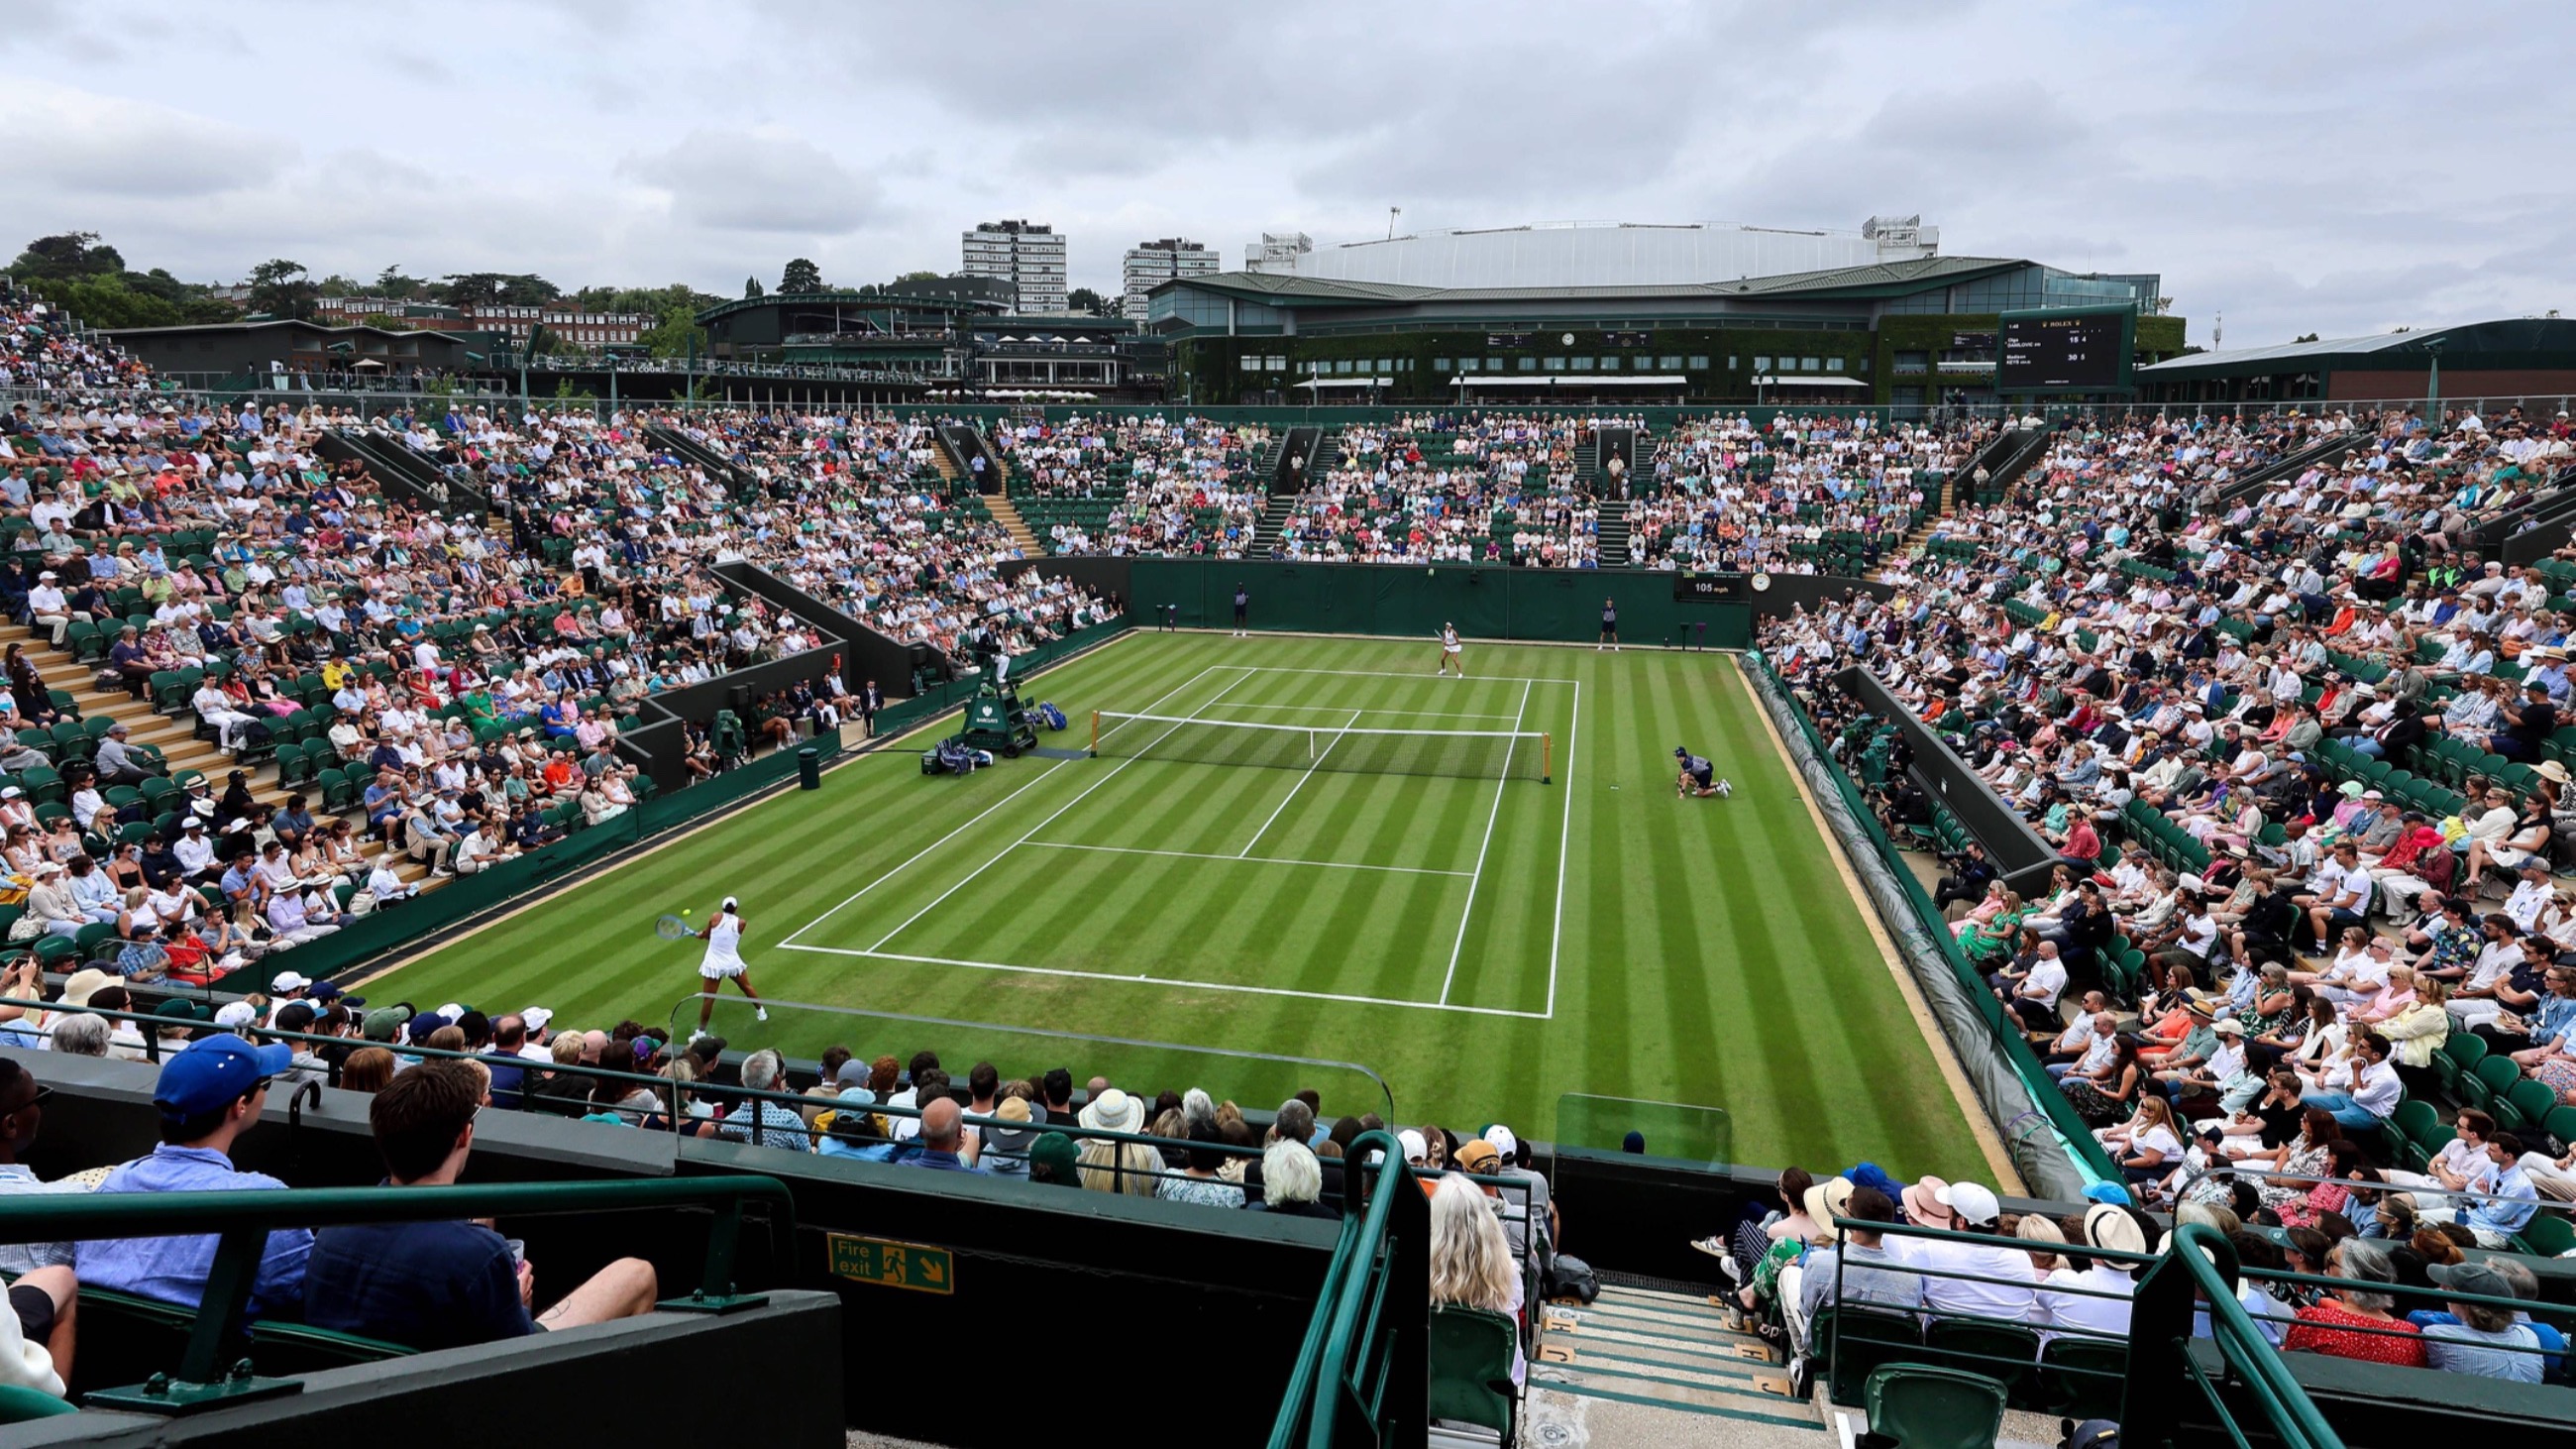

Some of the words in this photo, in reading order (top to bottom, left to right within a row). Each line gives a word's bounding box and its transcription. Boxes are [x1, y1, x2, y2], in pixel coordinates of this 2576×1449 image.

[1613, 441, 1619, 450] 2
[1695, 583, 1712, 592] 105
[837, 1240, 870, 1258] Fire
[838, 1260, 871, 1277] exit
[1552, 1322, 1570, 1333] H
[1546, 1349, 1568, 1362] J
[1742, 1349, 1764, 1361] H
